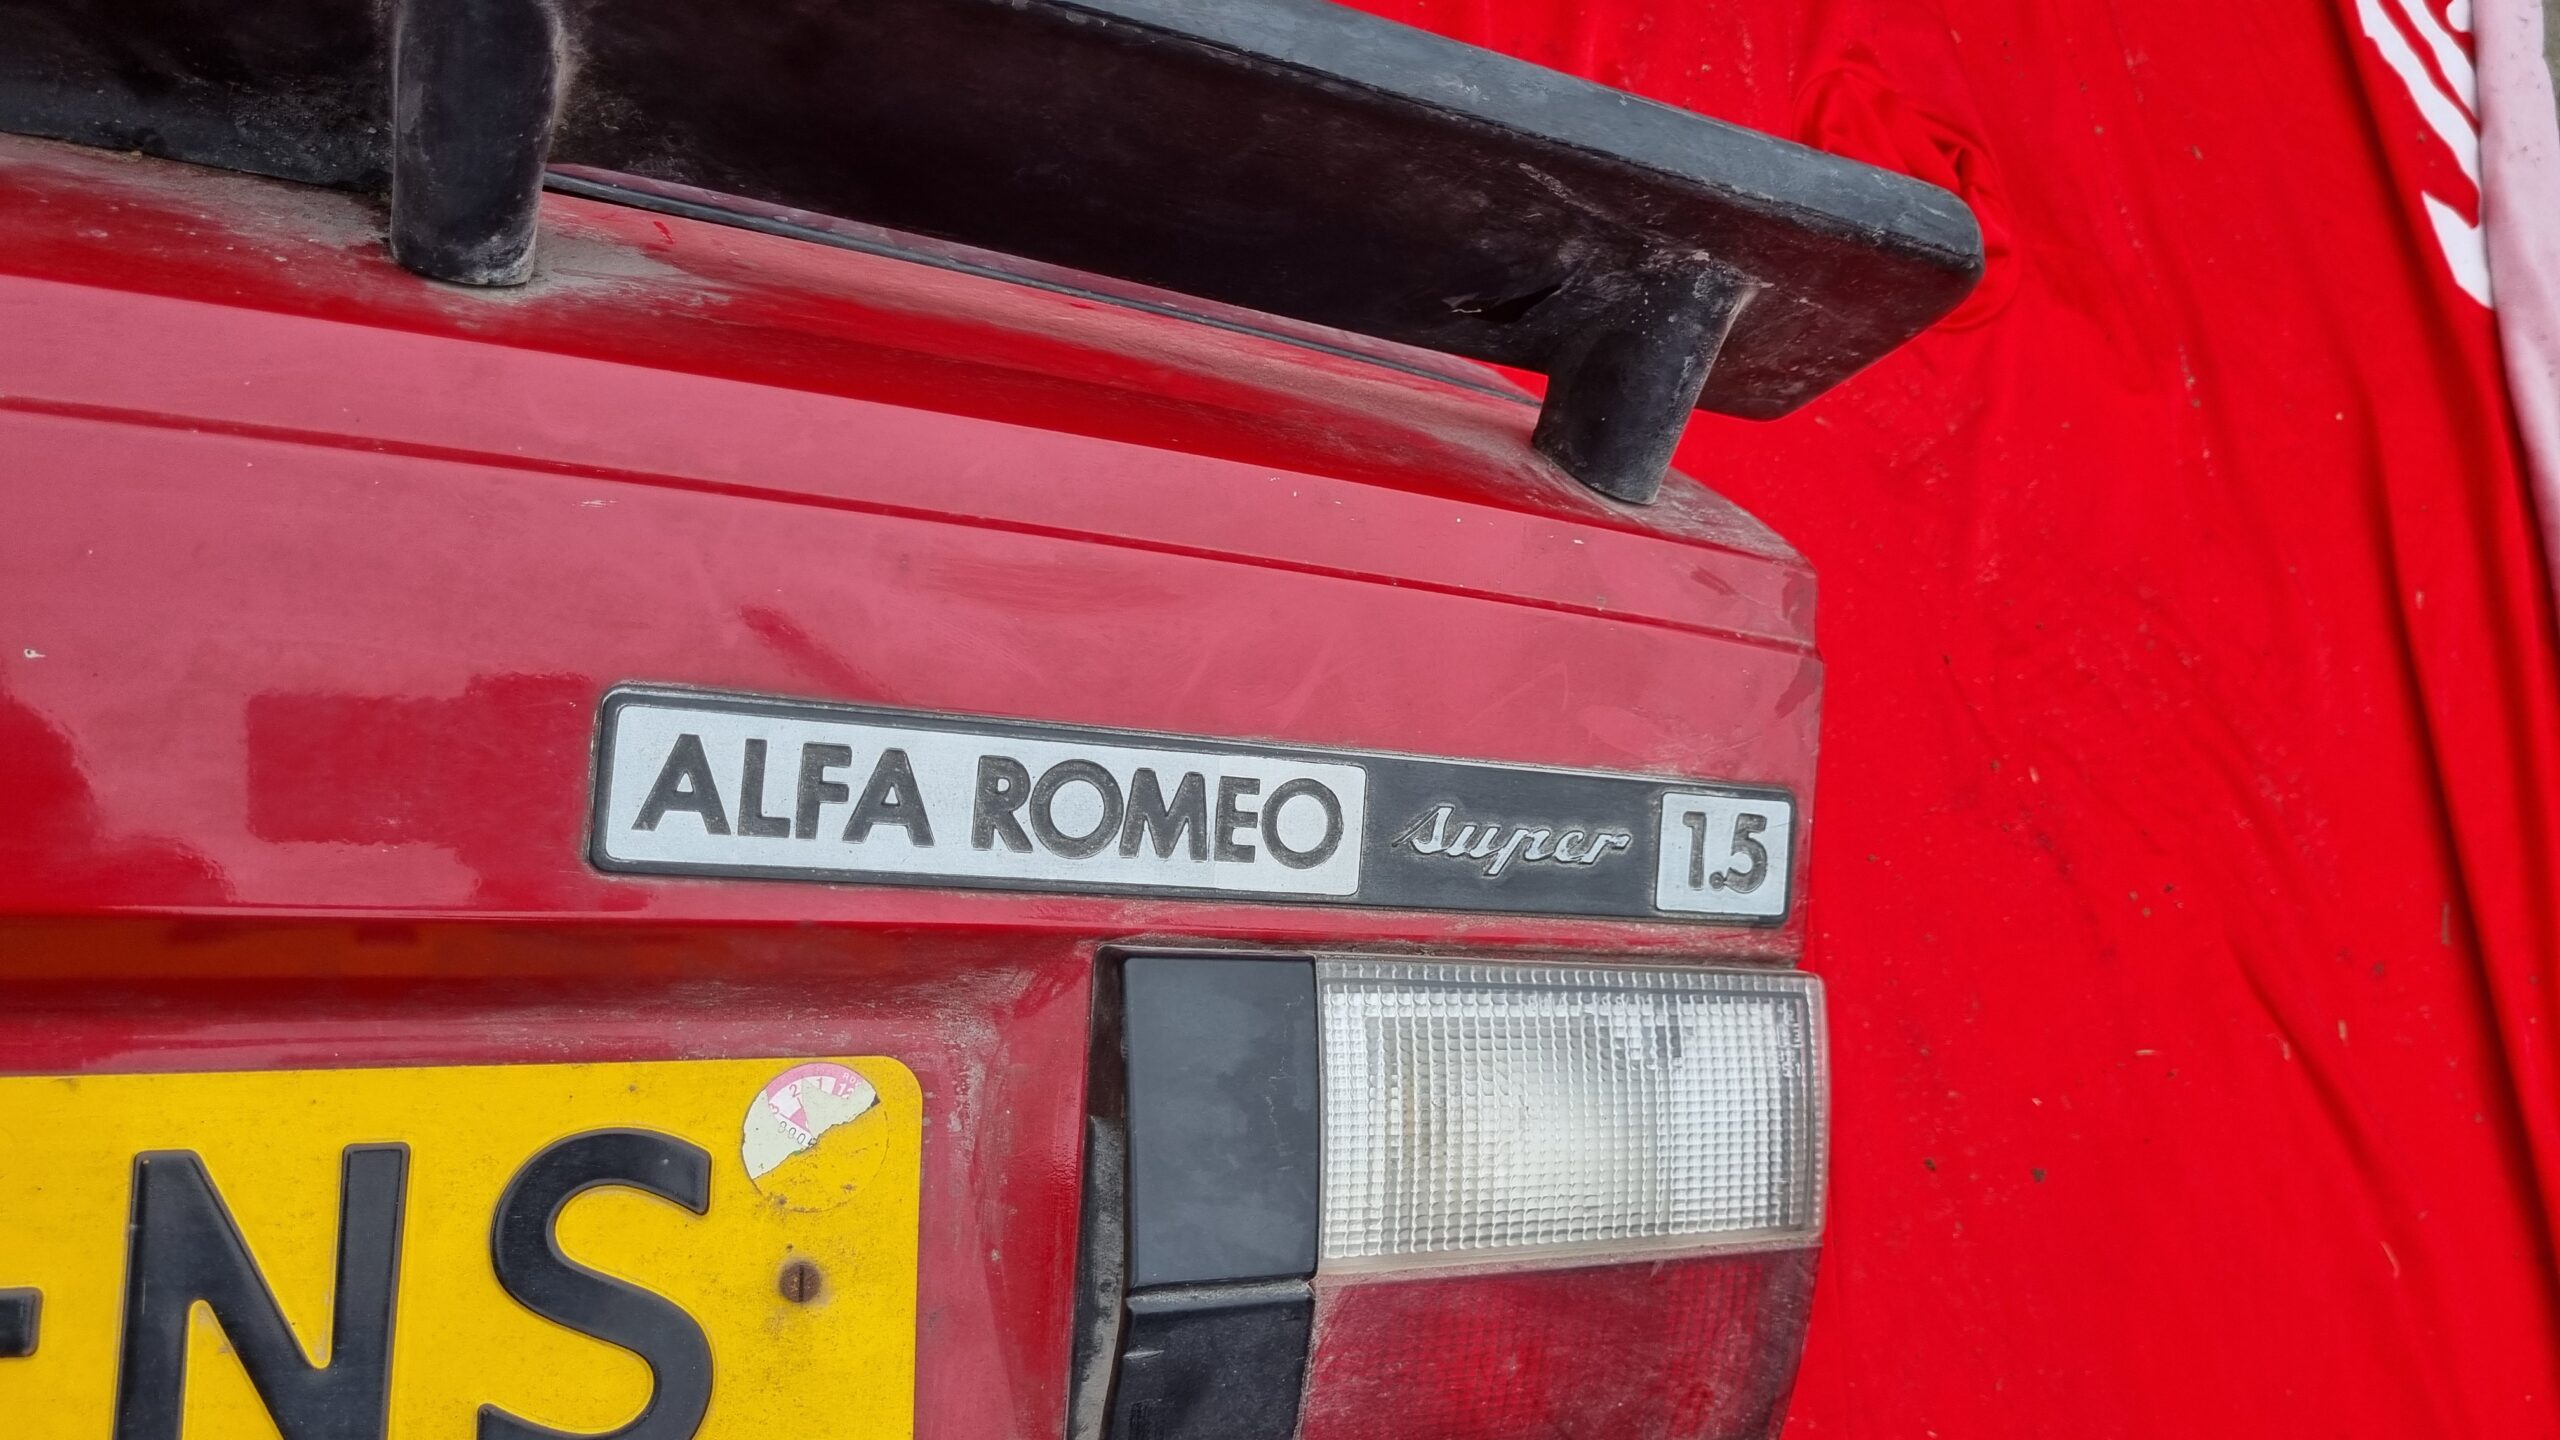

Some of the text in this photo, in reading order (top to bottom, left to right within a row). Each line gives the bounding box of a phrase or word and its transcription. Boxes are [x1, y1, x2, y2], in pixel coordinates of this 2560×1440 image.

[632, 733, 1767, 894] ALFA ROMEO super 1.5
